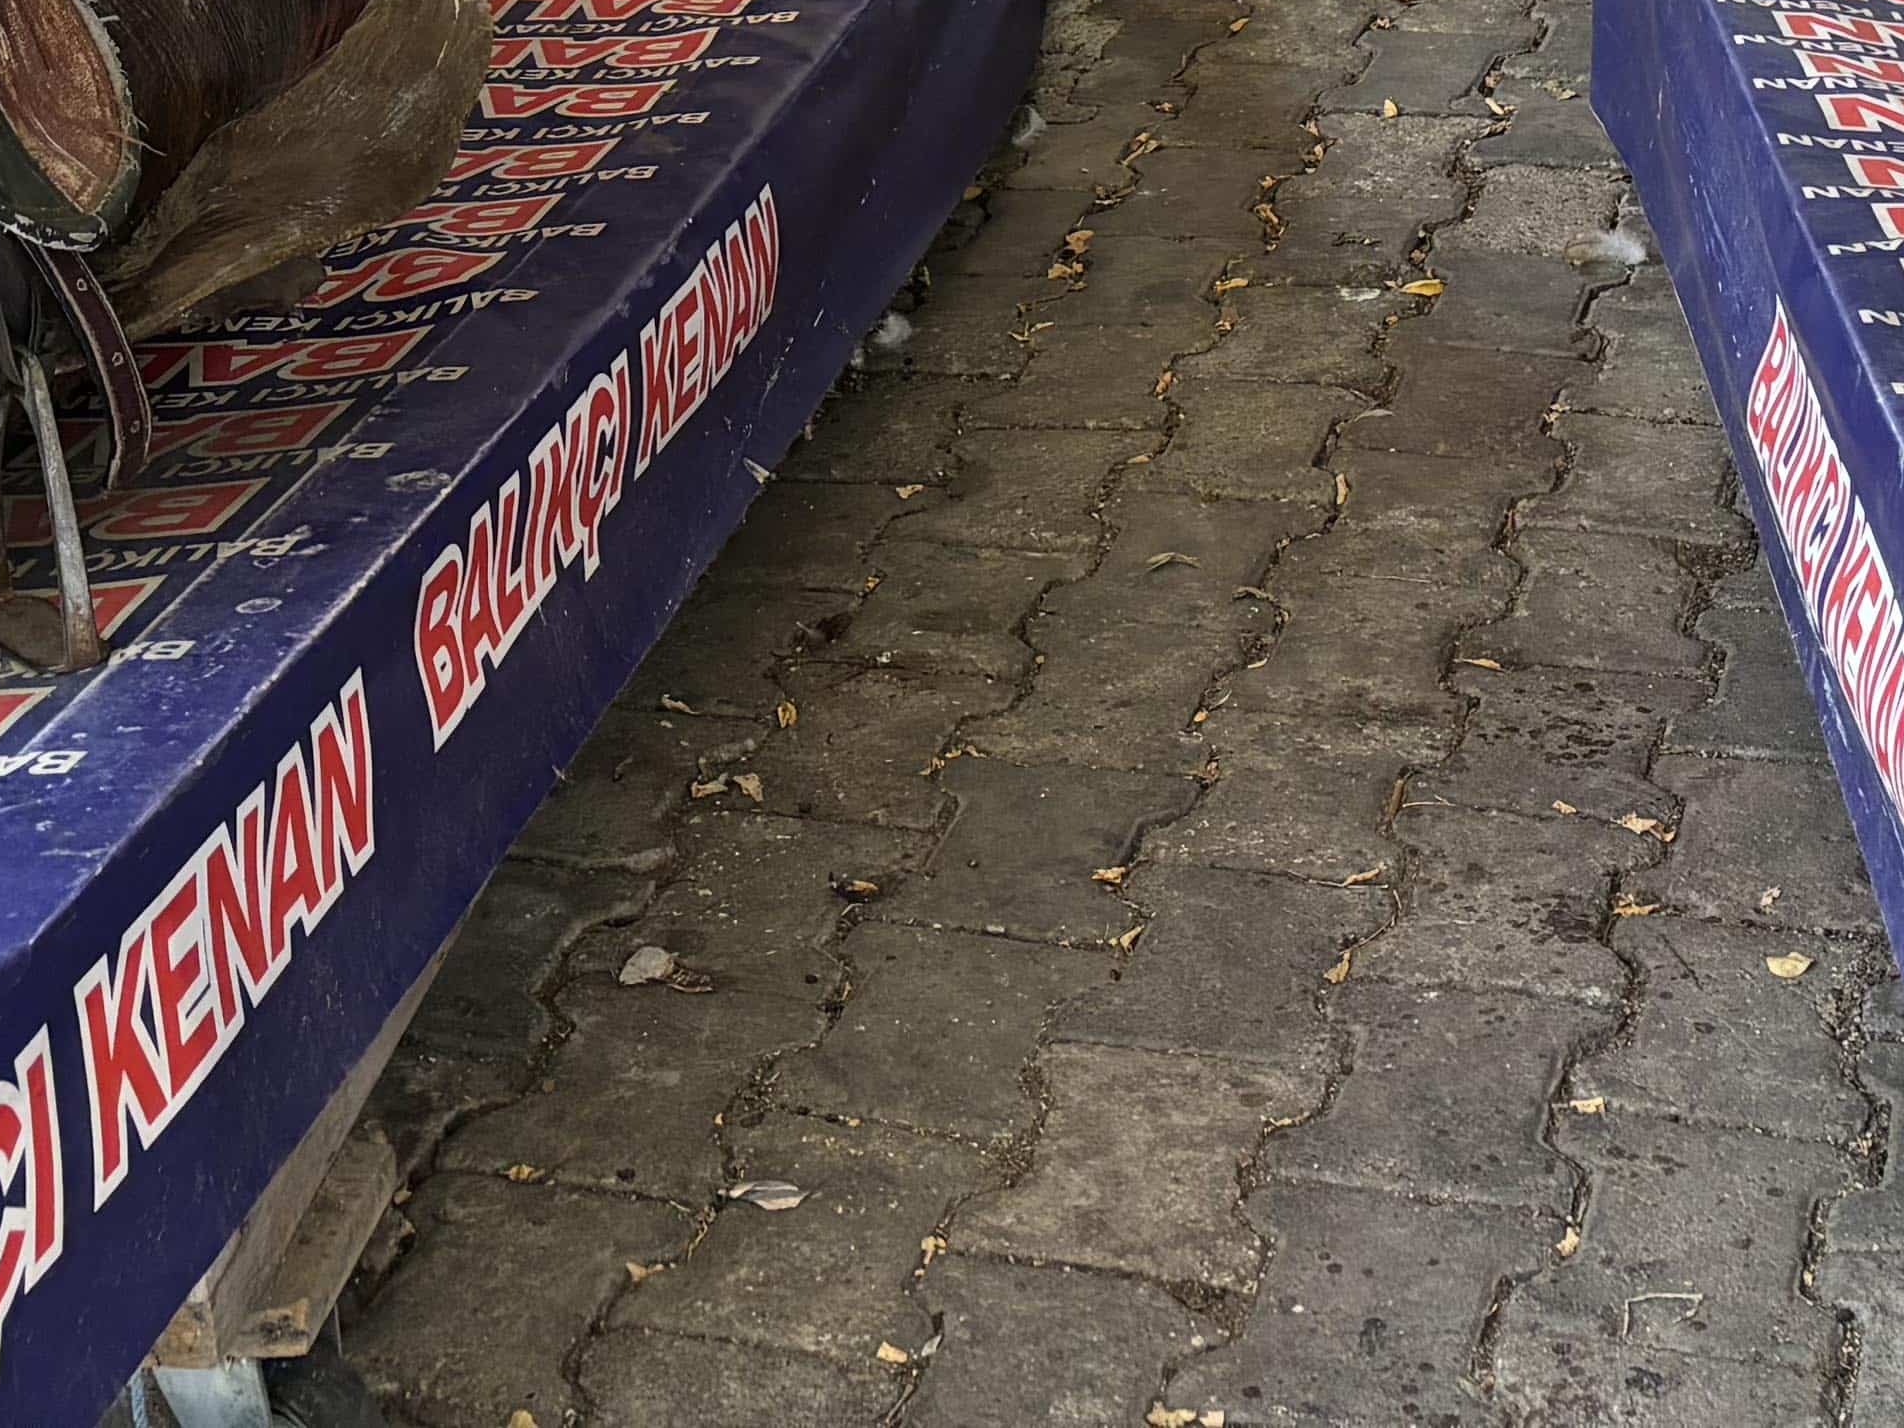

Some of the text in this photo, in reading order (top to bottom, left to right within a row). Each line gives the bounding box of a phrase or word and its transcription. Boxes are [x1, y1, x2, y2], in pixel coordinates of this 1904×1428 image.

[1734, 33, 1897, 58] KENAN
[415, 349, 632, 753] BALIKÇI
[634, 182, 780, 482] KENAN
[73, 666, 376, 1214] KENAN
